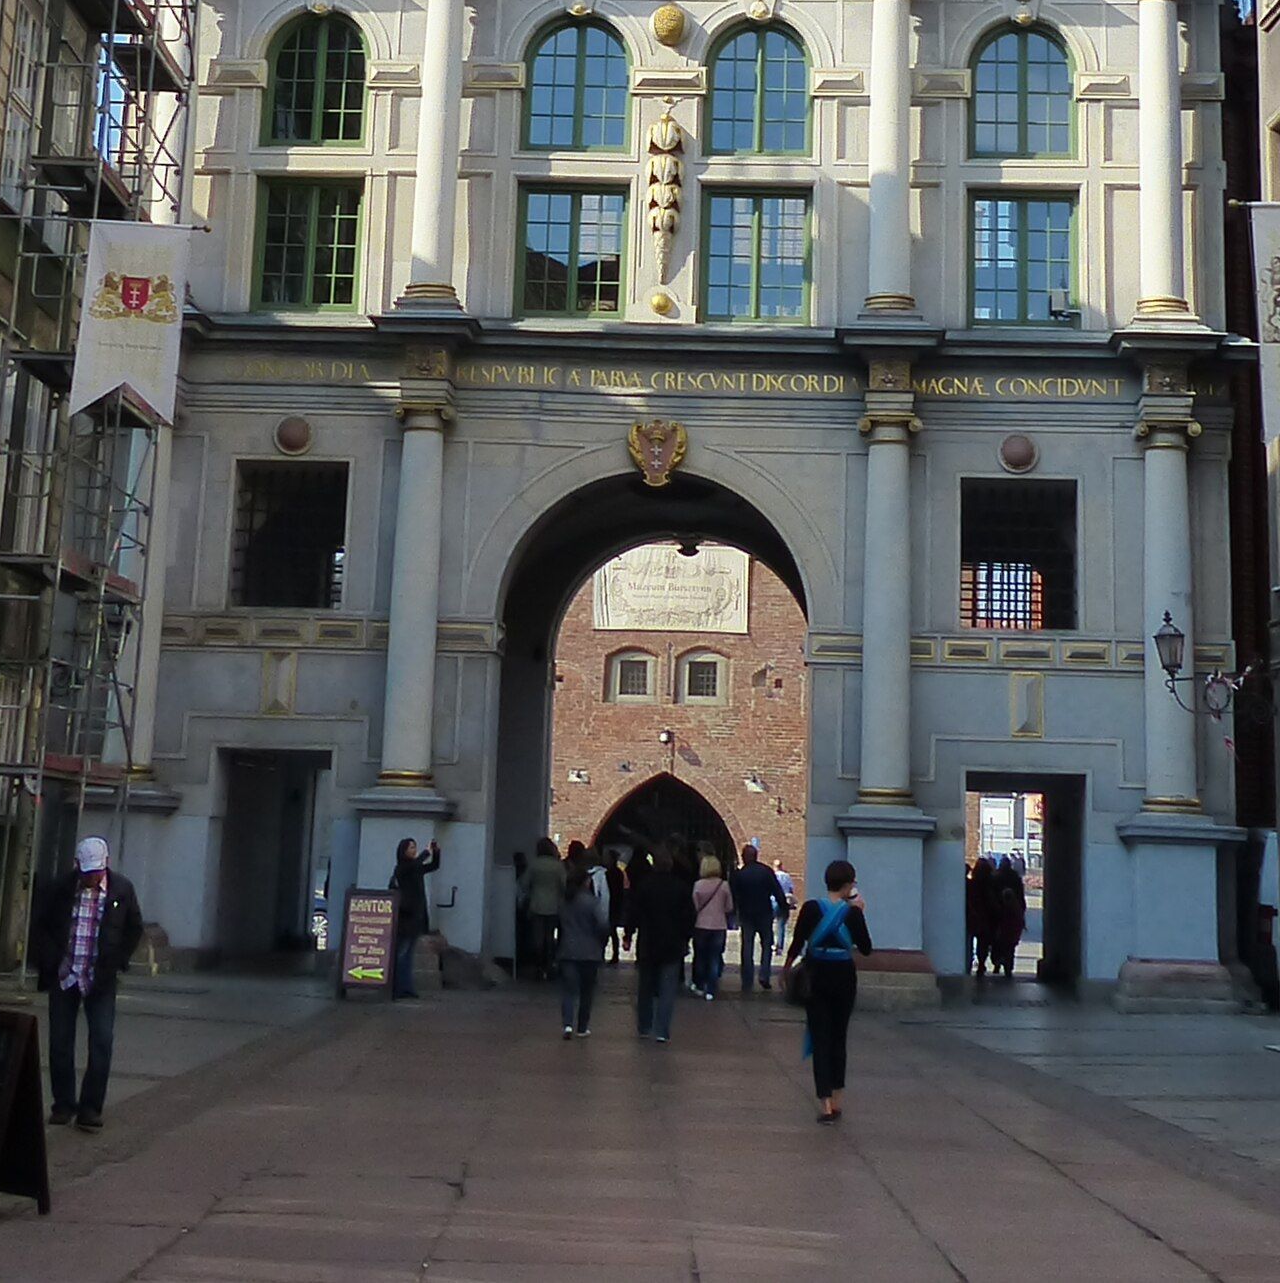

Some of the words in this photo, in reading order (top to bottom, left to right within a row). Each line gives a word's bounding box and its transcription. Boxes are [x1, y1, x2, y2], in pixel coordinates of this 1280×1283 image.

[651, 370, 748, 393] CRESCVNT
[995, 377, 1126, 397] CONCIDVNT
[349, 898, 393, 913] KANTOR
